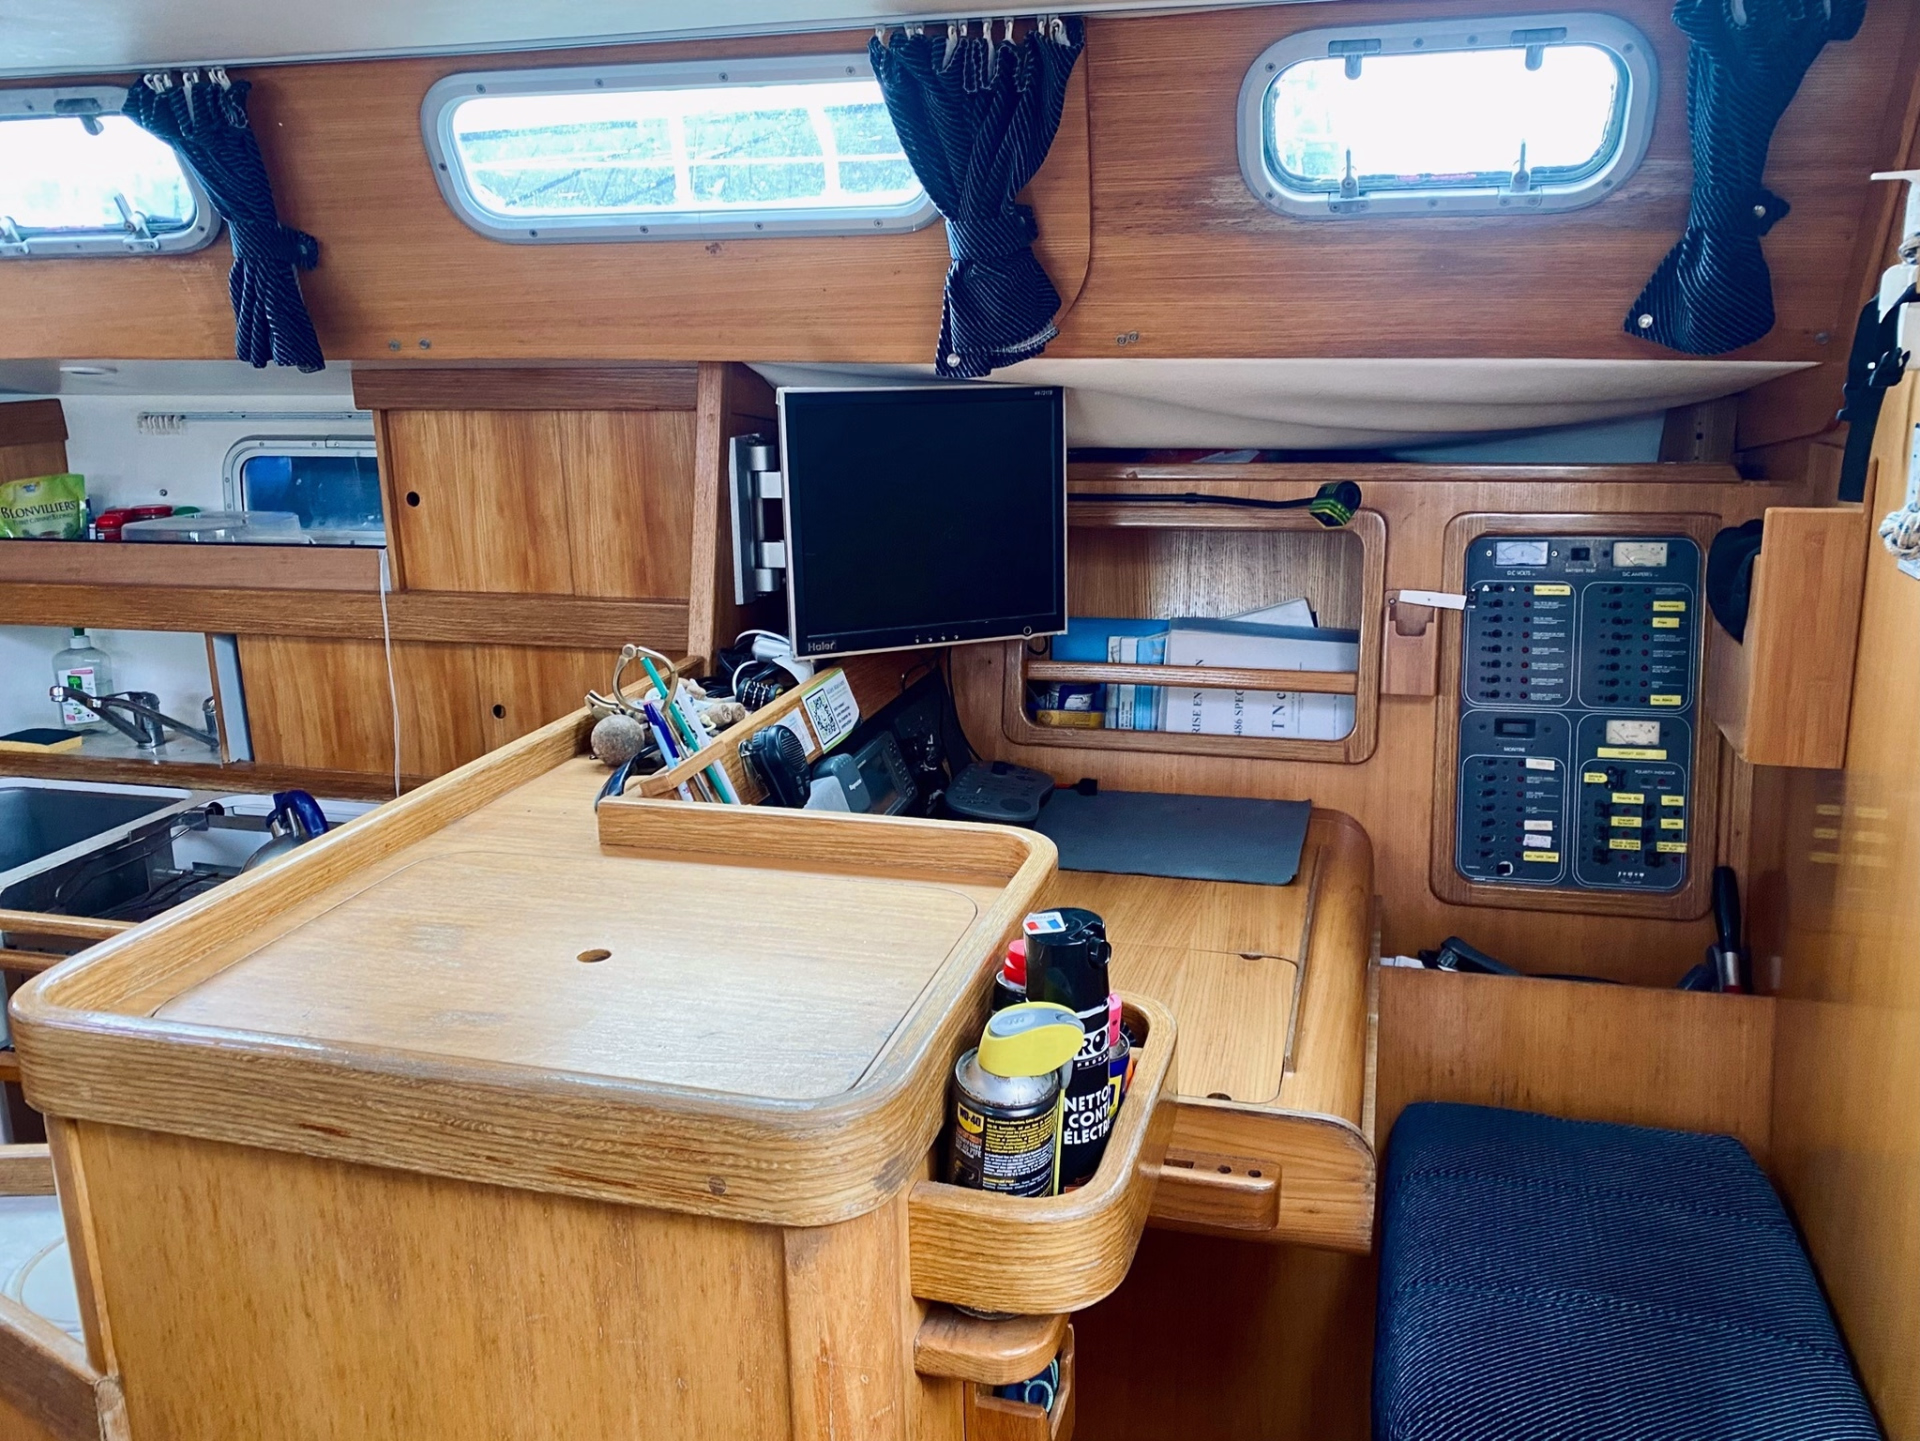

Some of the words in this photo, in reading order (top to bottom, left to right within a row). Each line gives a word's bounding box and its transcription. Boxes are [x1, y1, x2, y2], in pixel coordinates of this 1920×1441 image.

[0, 501, 76, 519] BLONVILLIERS
[807, 641, 836, 652] Haier
[1192, 691, 1203, 707] EN
[1077, 1025, 1110, 1057] RO
[1063, 1085, 1111, 1113] NETTO
[958, 1106, 982, 1127] WD-40
[1068, 1102, 1110, 1129] CONT
[1063, 1118, 1111, 1145] ÉLECTR
